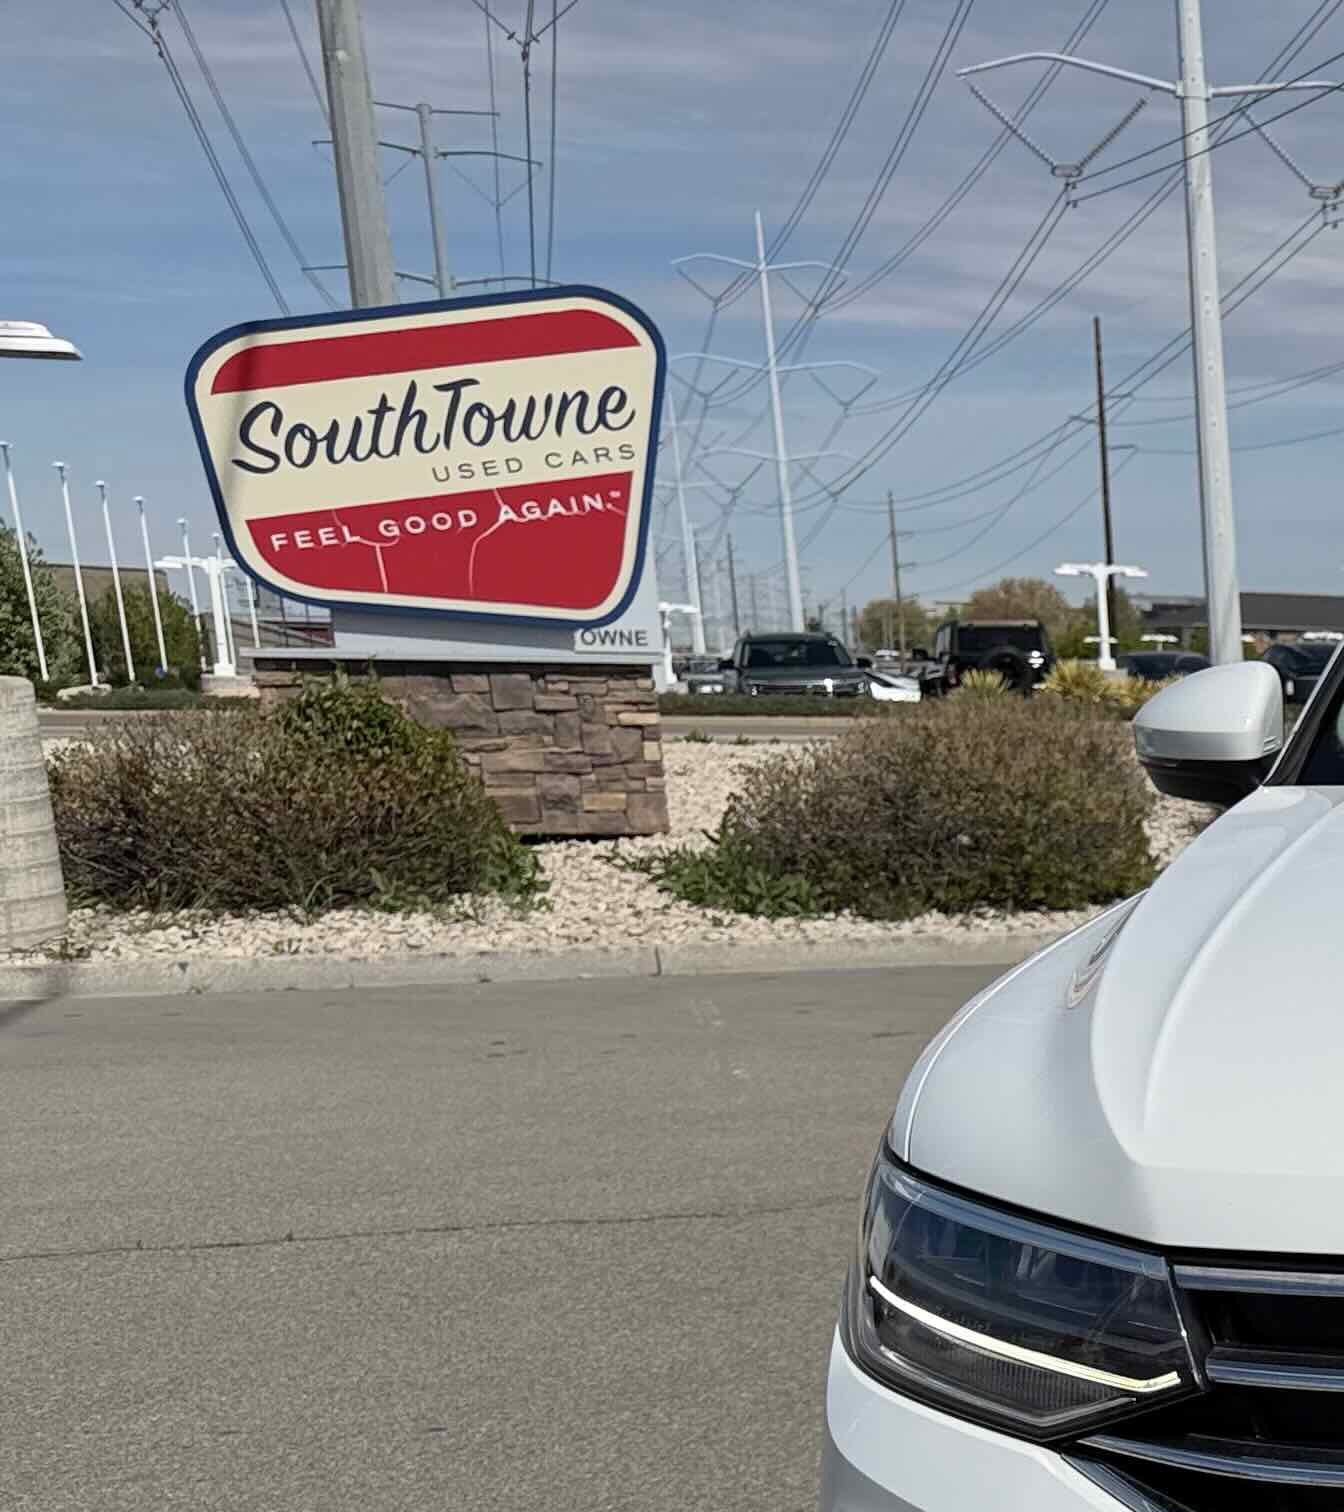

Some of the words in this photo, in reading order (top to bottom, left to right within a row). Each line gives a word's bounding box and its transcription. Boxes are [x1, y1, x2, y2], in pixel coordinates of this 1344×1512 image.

[231, 378, 636, 475] SouthTowne
[432, 457, 524, 483] USED
[544, 443, 636, 469] CARS
[270, 525, 361, 553] FEEL
[378, 509, 478, 538] GOOD
